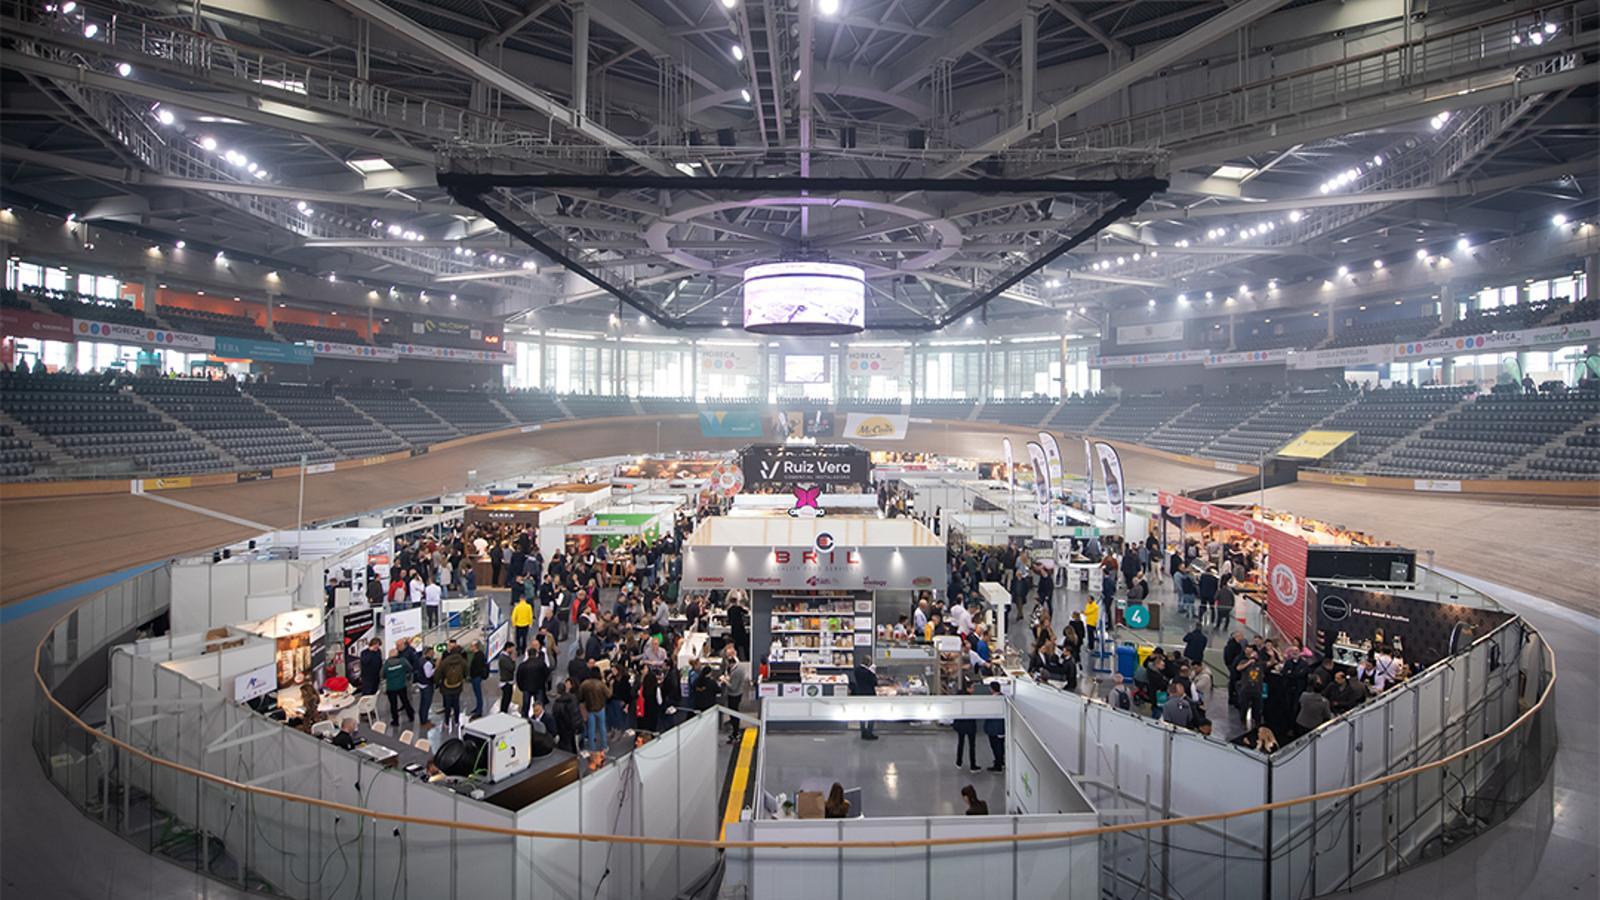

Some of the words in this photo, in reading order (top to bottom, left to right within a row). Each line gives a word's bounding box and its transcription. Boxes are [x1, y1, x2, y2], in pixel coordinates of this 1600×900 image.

[784, 460, 815, 474] Ruiz
[816, 461, 852, 474] Vera
[775, 550, 861, 565] BRIL
[1131, 609, 1142, 624] 4
